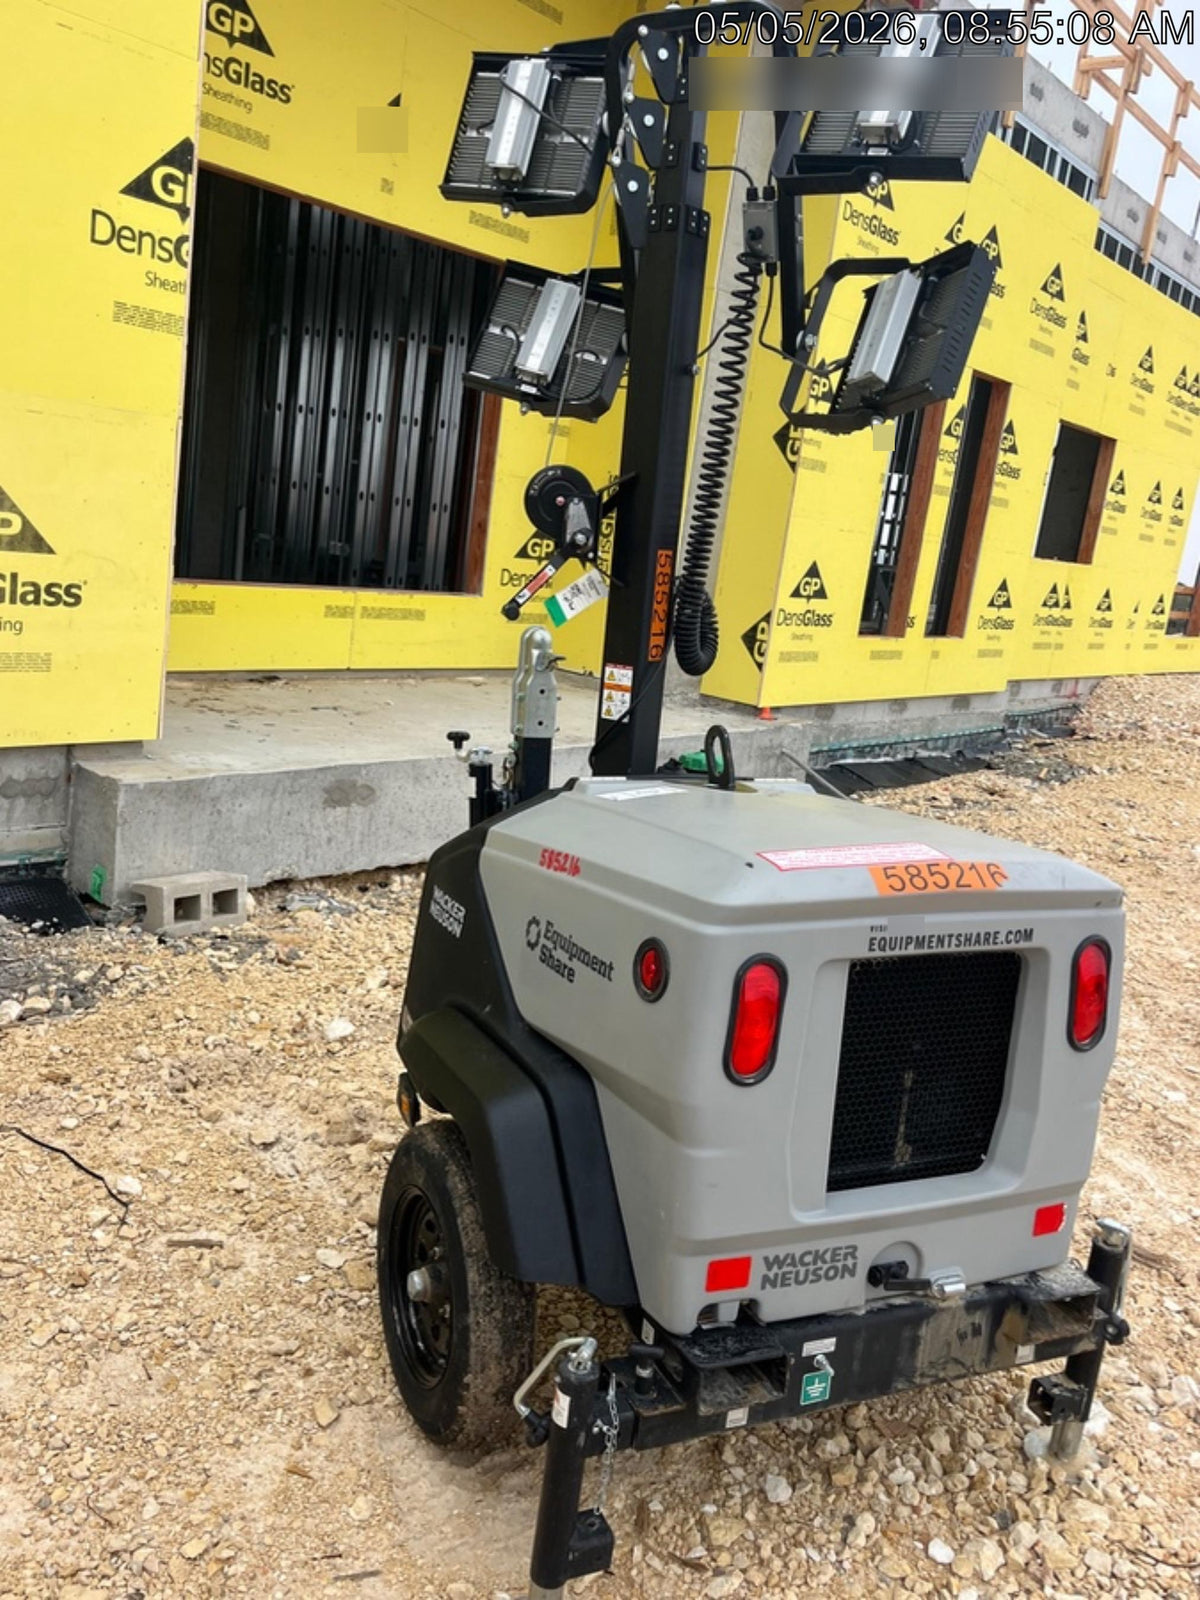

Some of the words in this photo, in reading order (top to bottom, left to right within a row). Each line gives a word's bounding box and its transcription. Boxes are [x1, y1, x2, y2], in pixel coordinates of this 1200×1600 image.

[208, 2, 255, 38] GP
[527, 538, 554, 558] GP
[0, 571, 82, 608] lass
[800, 577, 821, 596] GP
[650, 552, 673, 658] 585216
[777, 608, 833, 628] DensGlass
[544, 920, 614, 982] Equipment
[868, 928, 1034, 952] EQUIPMENTSHARE.COM
[539, 944, 576, 983] Share
[763, 1244, 858, 1272] WACKER
[761, 1262, 857, 1291] NEUSON
